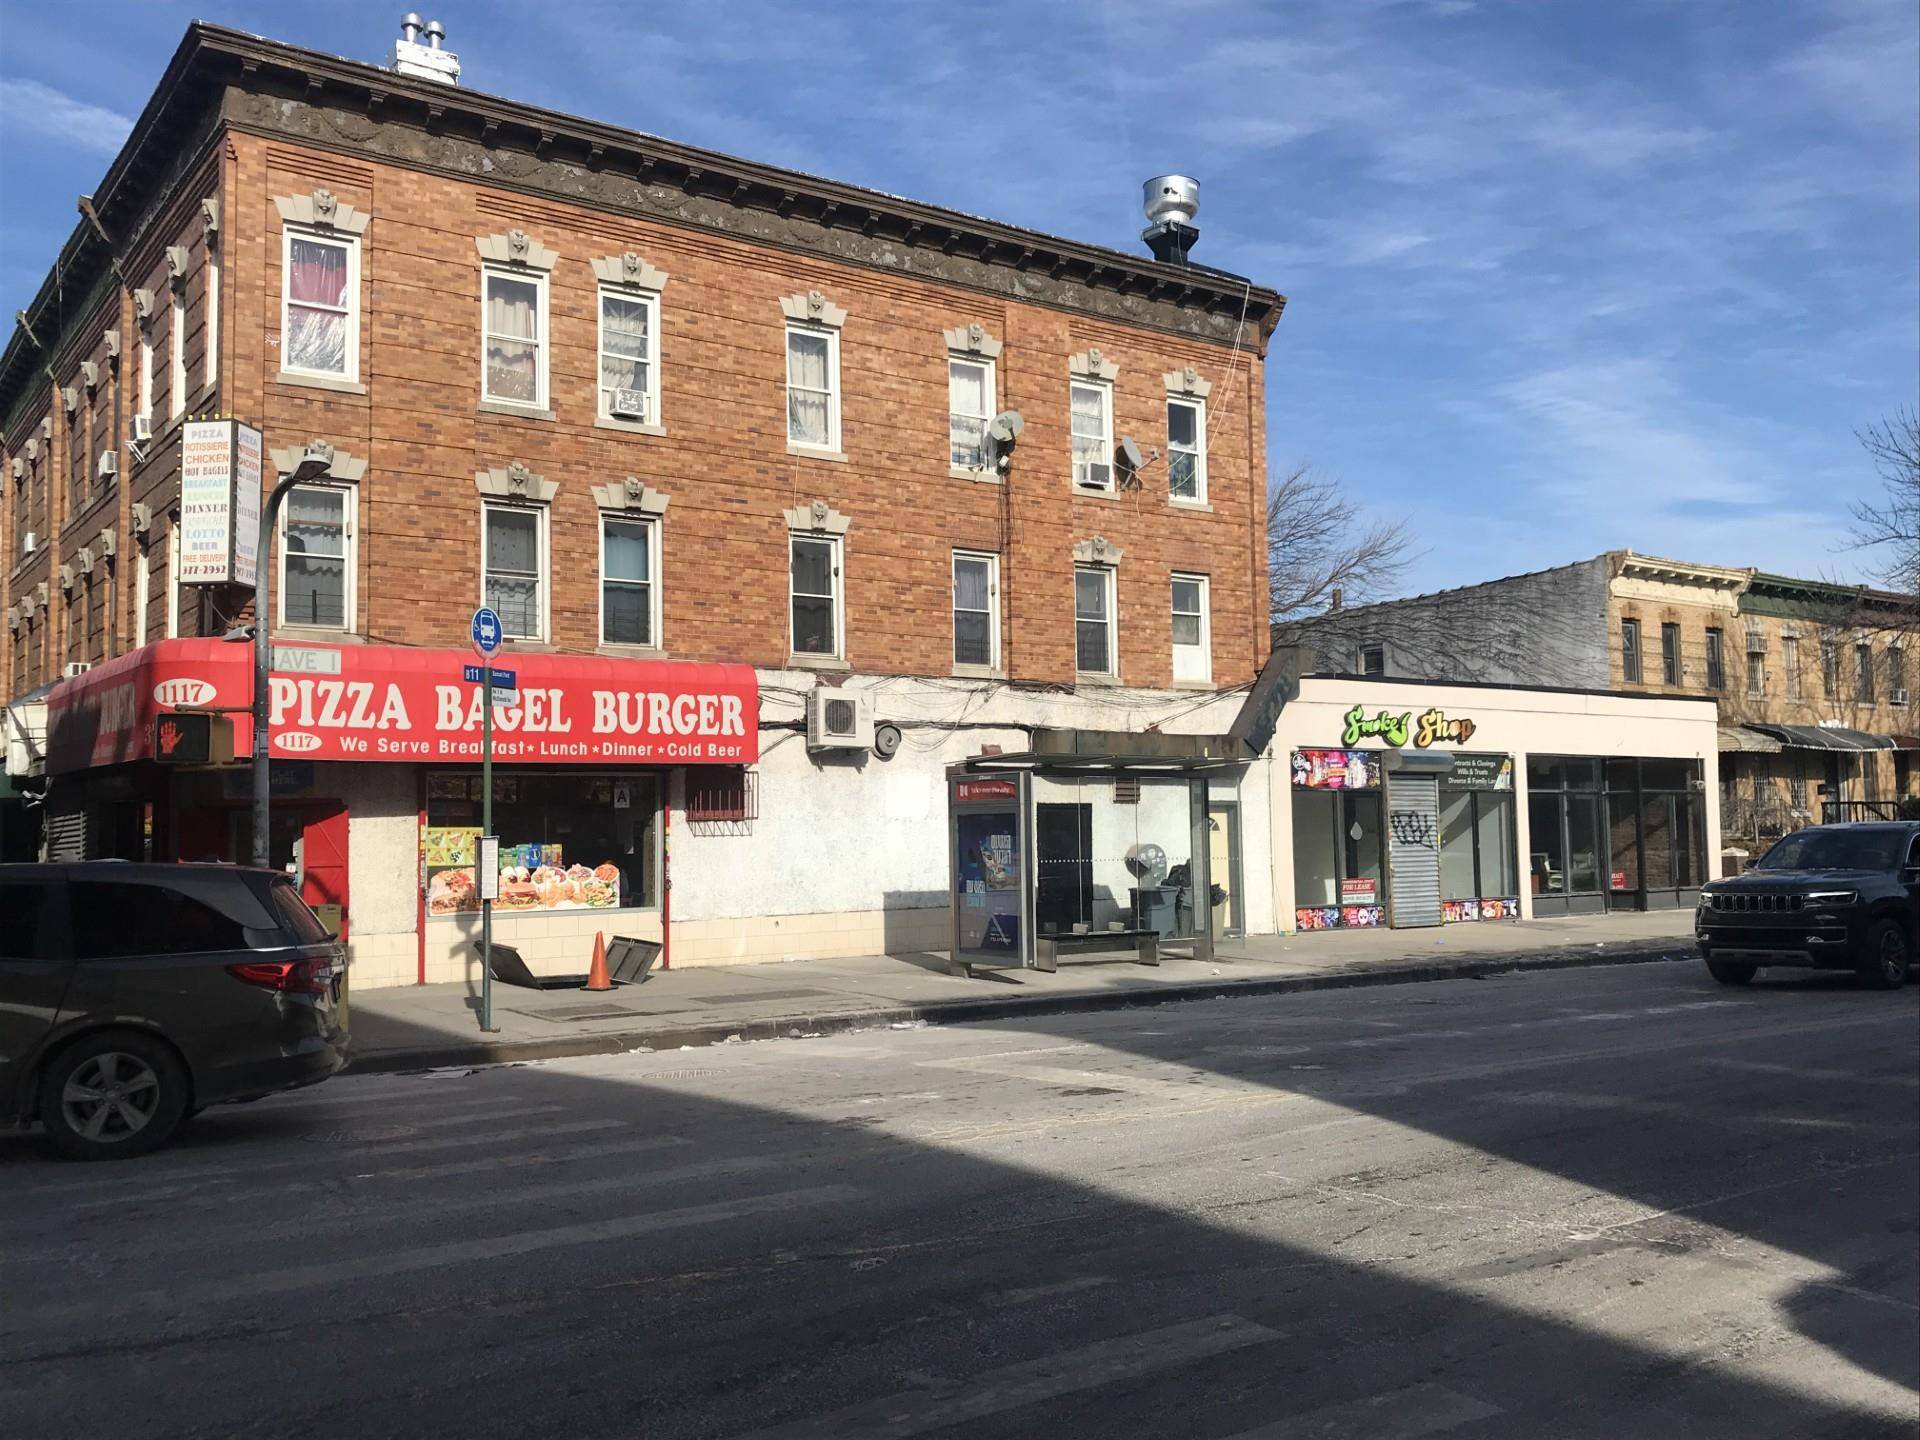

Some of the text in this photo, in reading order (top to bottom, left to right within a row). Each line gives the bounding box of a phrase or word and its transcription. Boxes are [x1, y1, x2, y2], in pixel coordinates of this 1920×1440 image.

[191, 429, 224, 439] PIZZA
[185, 453, 230, 465] CHICKEN
[184, 467, 199, 477] HOT
[184, 479, 227, 489] BREAKFAST
[184, 503, 228, 514] DINNER
[186, 528, 225, 539] LOTTO
[191, 542, 218, 551] BEER
[280, 650, 317, 670] AVE
[465, 668, 479, 680] B11
[161, 684, 203, 703] 1117
[268, 677, 746, 737] PIZZA BAGEL BURGER
[1341, 704, 1476, 749] Smoke Shop
[281, 734, 314, 748] 1117
[340, 736, 368, 752] We
[377, 738, 430, 753] Serve
[540, 741, 588, 755] Lunch
[602, 742, 653, 756] Dinner
[667, 742, 701, 757] Cold
[708, 743, 742, 757] Beer
[1471, 778, 1488, 786] Family
